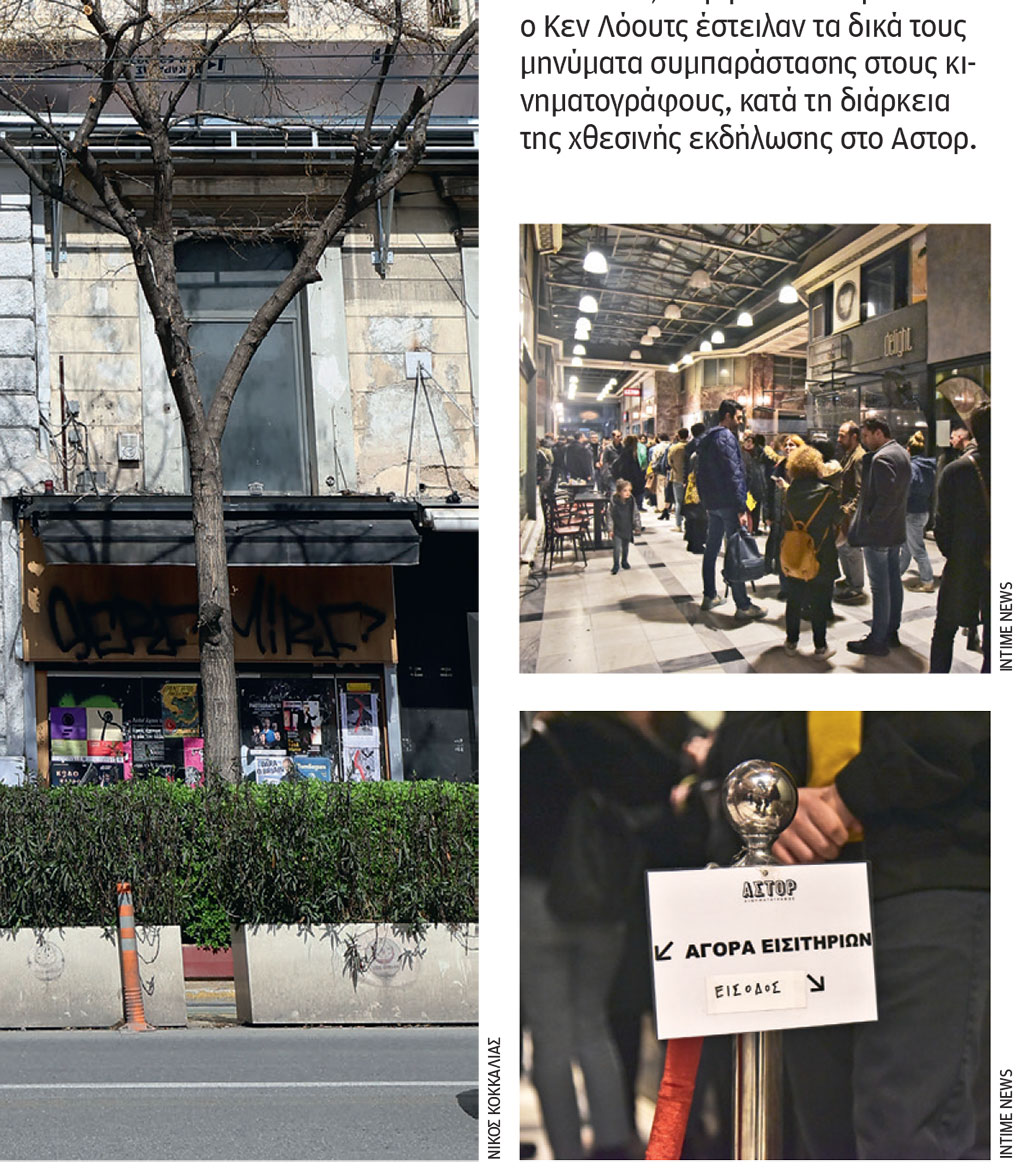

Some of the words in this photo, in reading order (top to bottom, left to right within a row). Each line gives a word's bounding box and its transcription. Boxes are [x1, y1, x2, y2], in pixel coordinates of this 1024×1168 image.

[883, 327, 913, 357] delight
[742, 879, 797, 898] ΑΣΤΟΡ
[685, 940, 756, 960] ΑΓΟΡΑ
[761, 932, 872, 954] ΕΙΣΙΤΗΡΙΩΝ
[714, 980, 782, 999] ΕΙΣΟΔΟΣ
